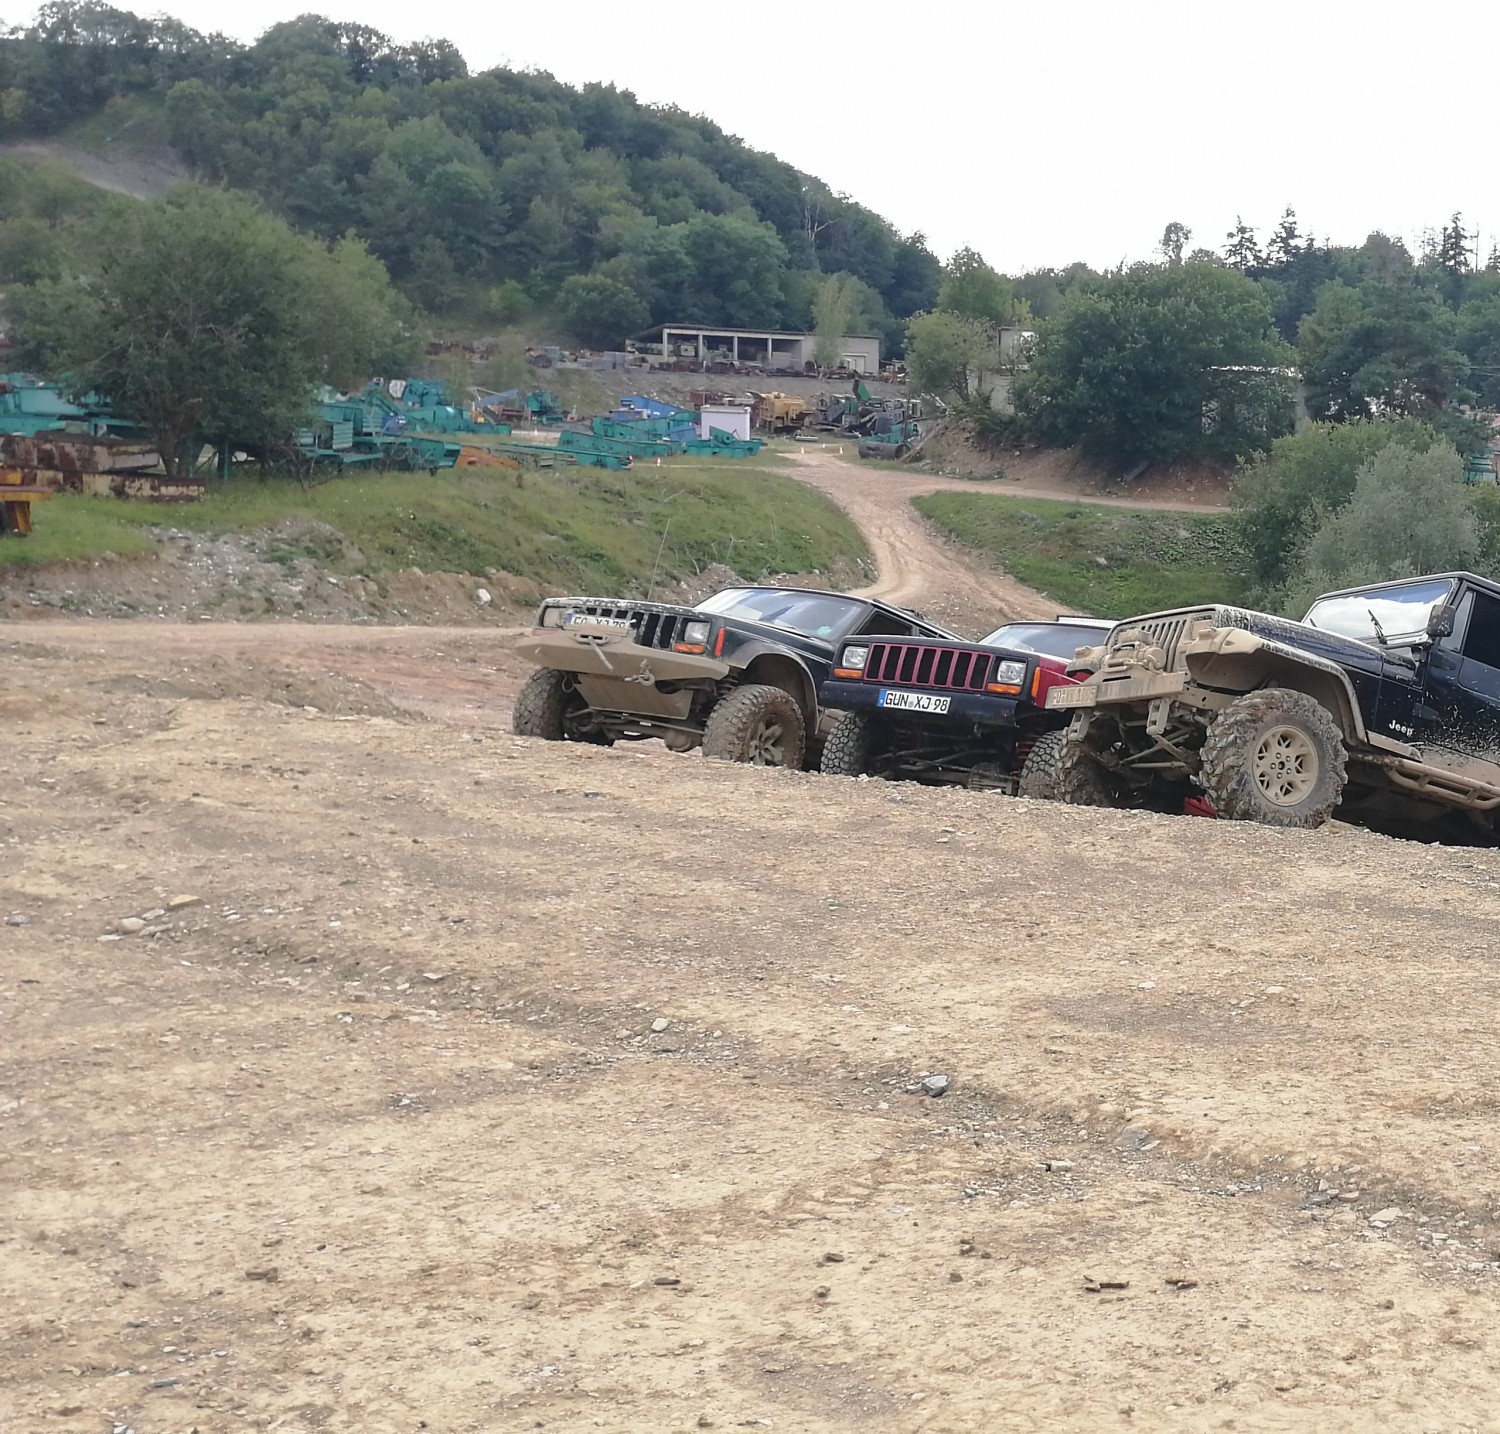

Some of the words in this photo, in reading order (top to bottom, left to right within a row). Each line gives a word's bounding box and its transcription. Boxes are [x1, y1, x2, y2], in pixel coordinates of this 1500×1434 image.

[885, 692, 909, 707] GUN
[914, 695, 932, 710] XJ
[933, 698, 949, 712] 98
[1388, 719, 1415, 738] Jeep
